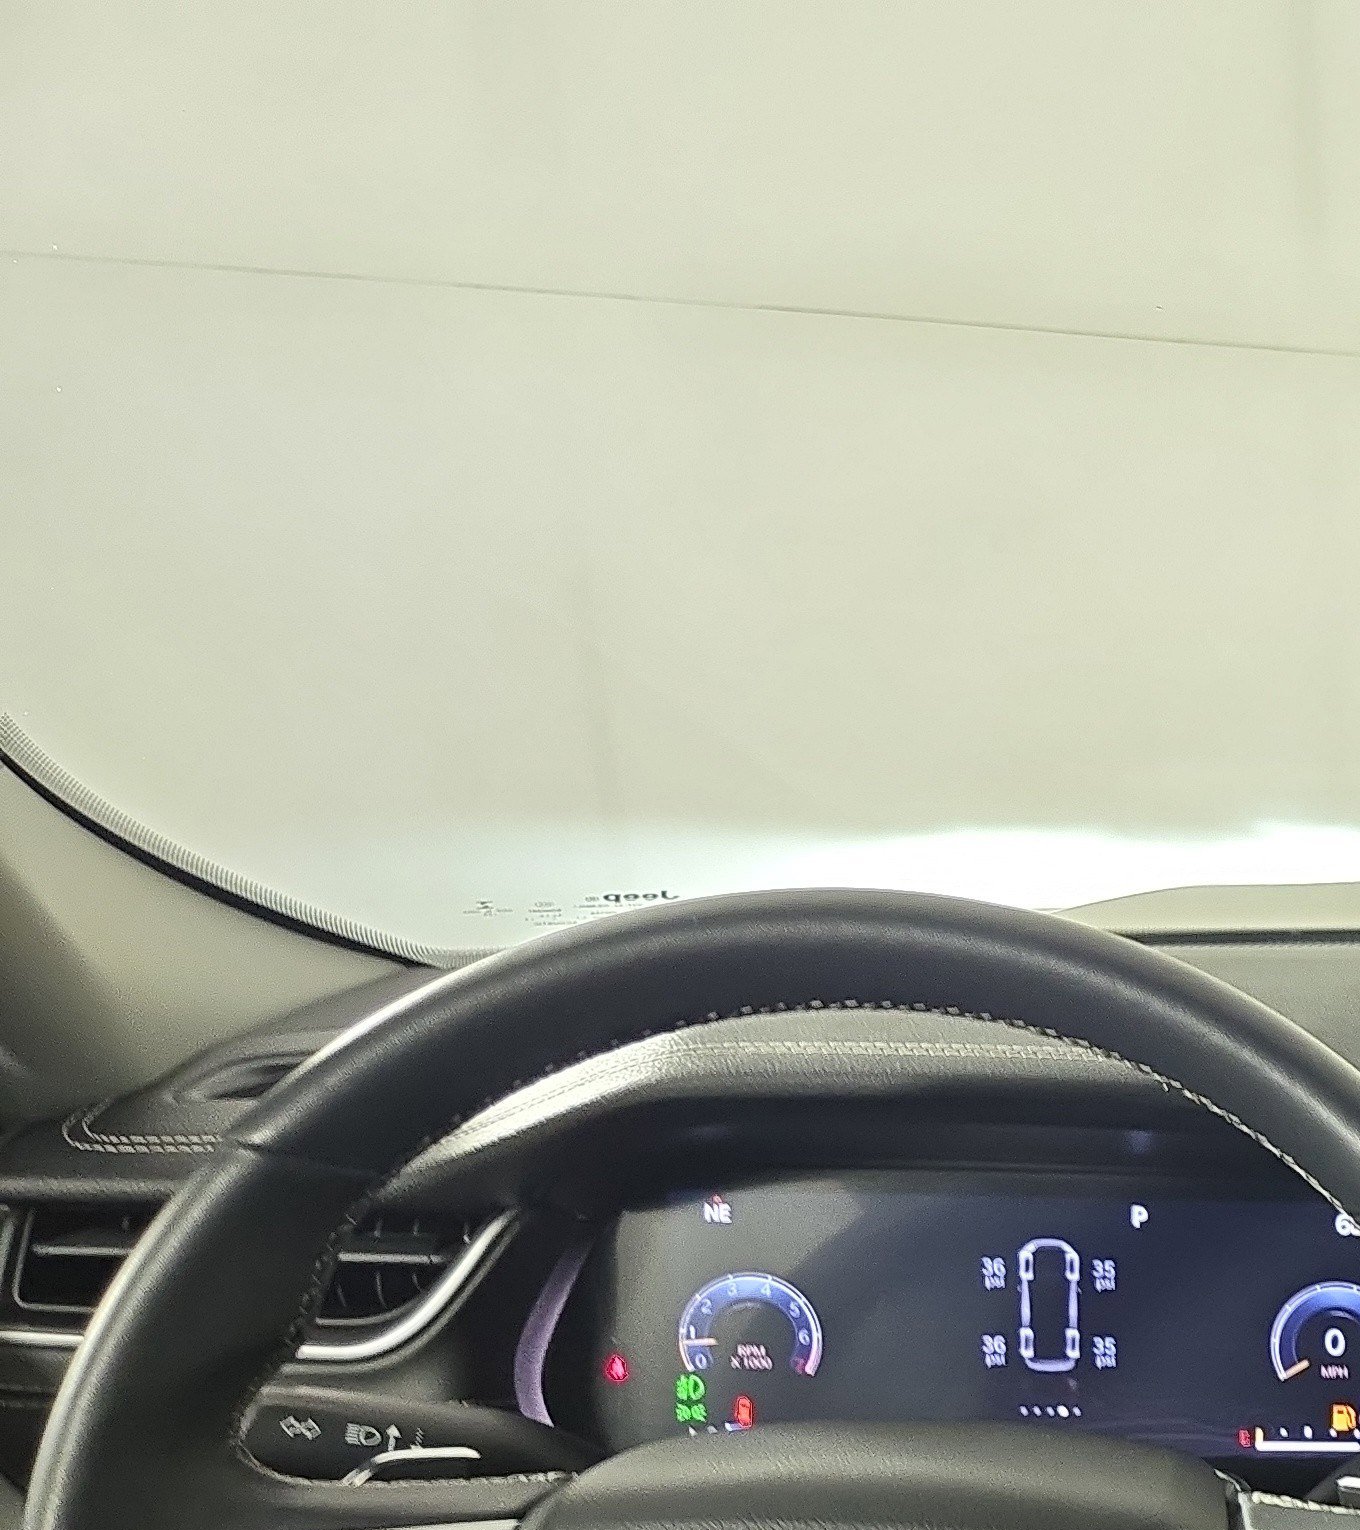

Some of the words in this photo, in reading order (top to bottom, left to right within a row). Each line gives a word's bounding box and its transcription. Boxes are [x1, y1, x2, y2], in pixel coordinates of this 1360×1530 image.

[703, 1203, 733, 1224] NE
[1130, 1204, 1149, 1228] P
[1324, 1327, 1346, 1357] 0
[1321, 1364, 1349, 1379] MPH
